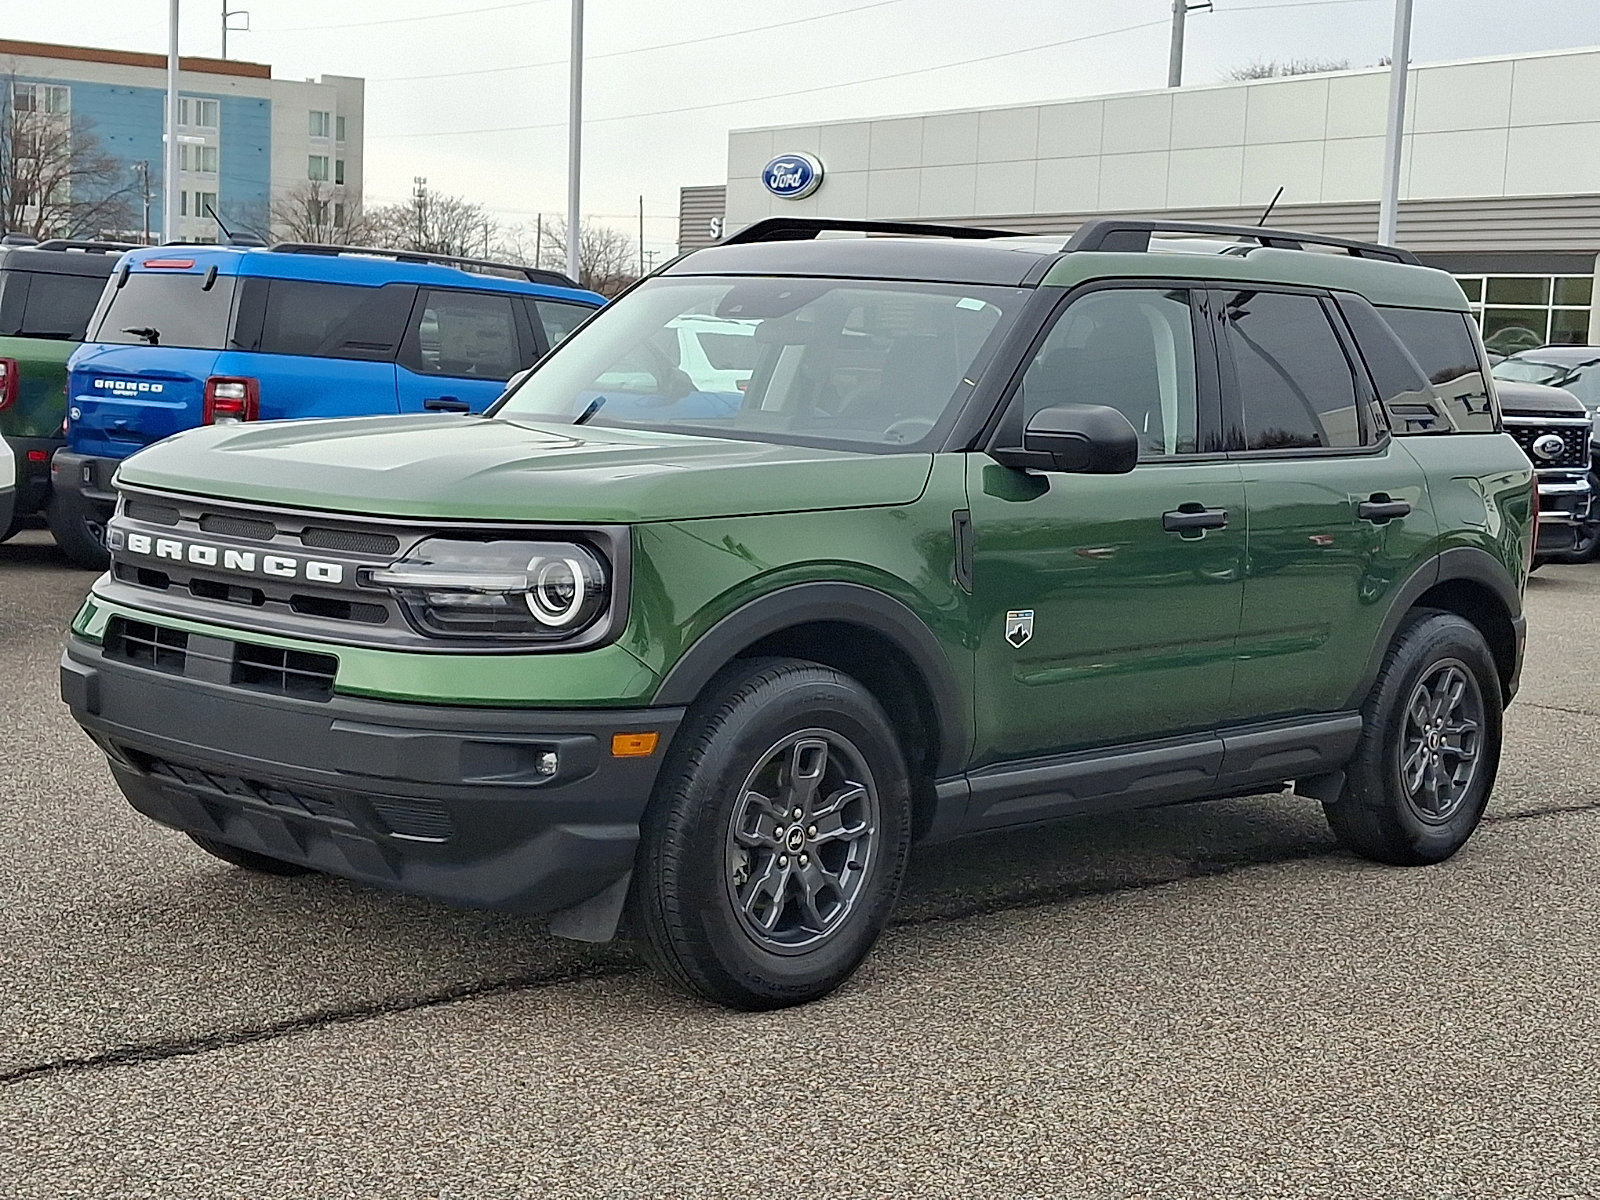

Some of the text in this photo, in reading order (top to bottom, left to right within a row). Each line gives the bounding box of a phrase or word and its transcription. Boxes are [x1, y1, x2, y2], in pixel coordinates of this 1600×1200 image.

[770, 162, 802, 189] Ford
[94, 379, 163, 393] BRONCO
[127, 533, 343, 584] BRONCO
